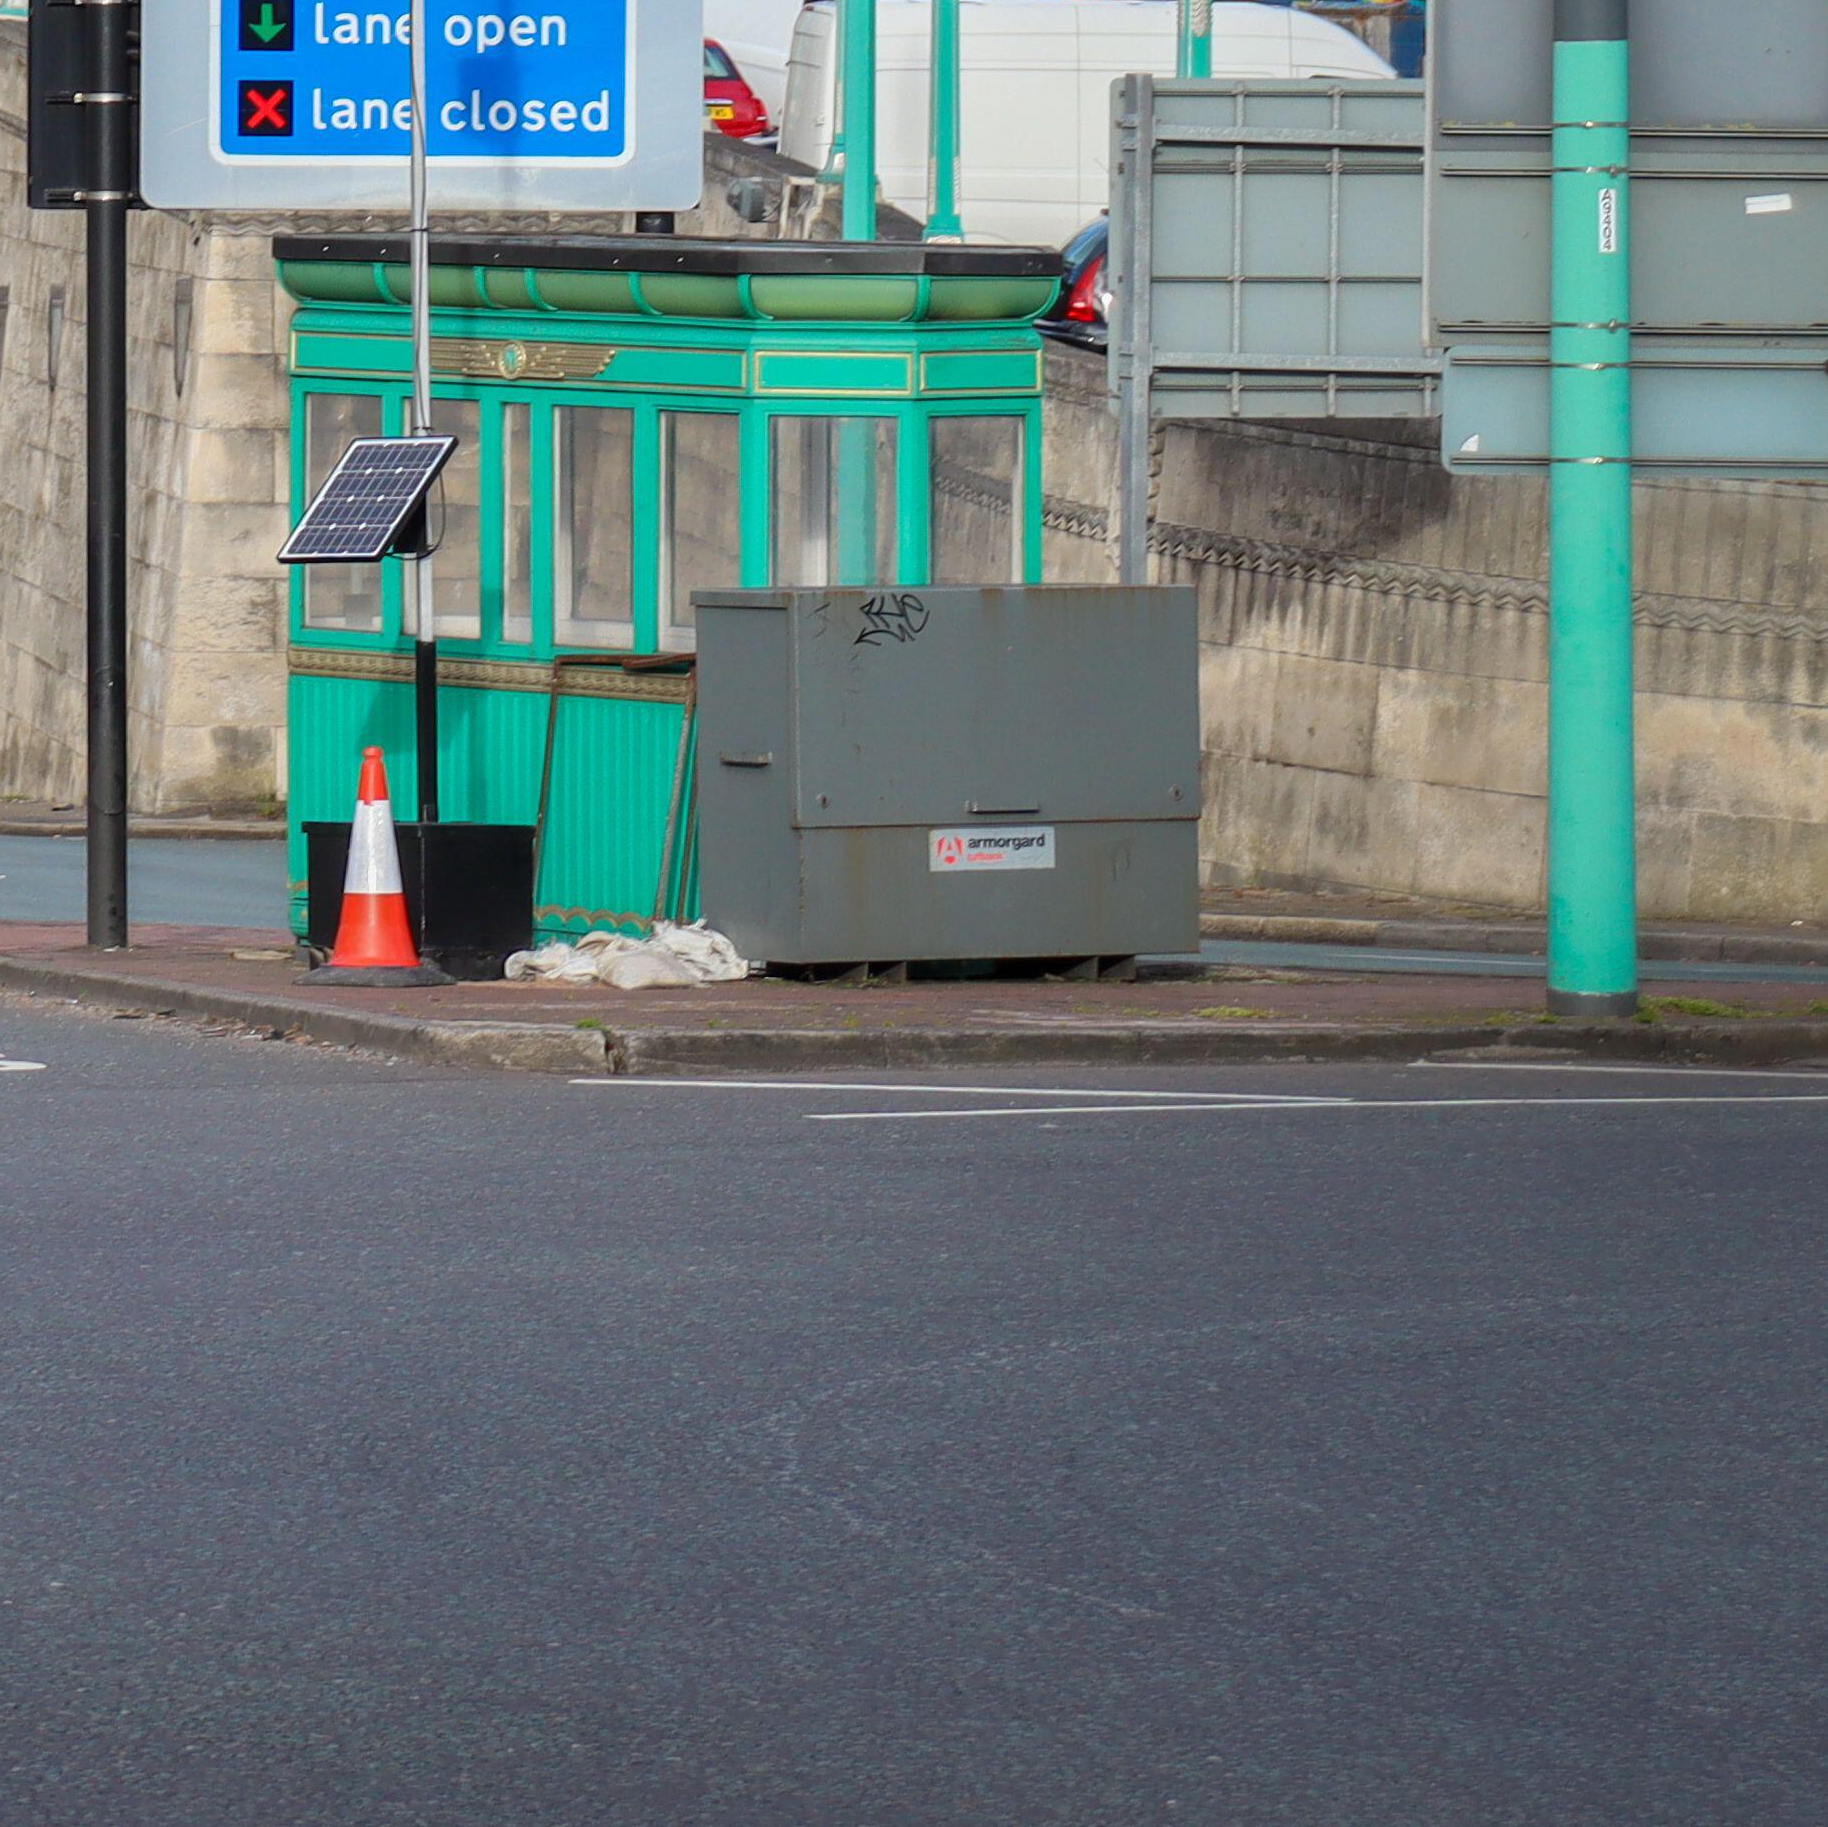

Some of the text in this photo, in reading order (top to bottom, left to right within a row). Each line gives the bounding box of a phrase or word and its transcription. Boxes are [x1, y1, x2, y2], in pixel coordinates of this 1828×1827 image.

[314, 2, 567, 54] lane open
[312, 87, 610, 133] lane closed
[968, 834, 1046, 850] armorgard
